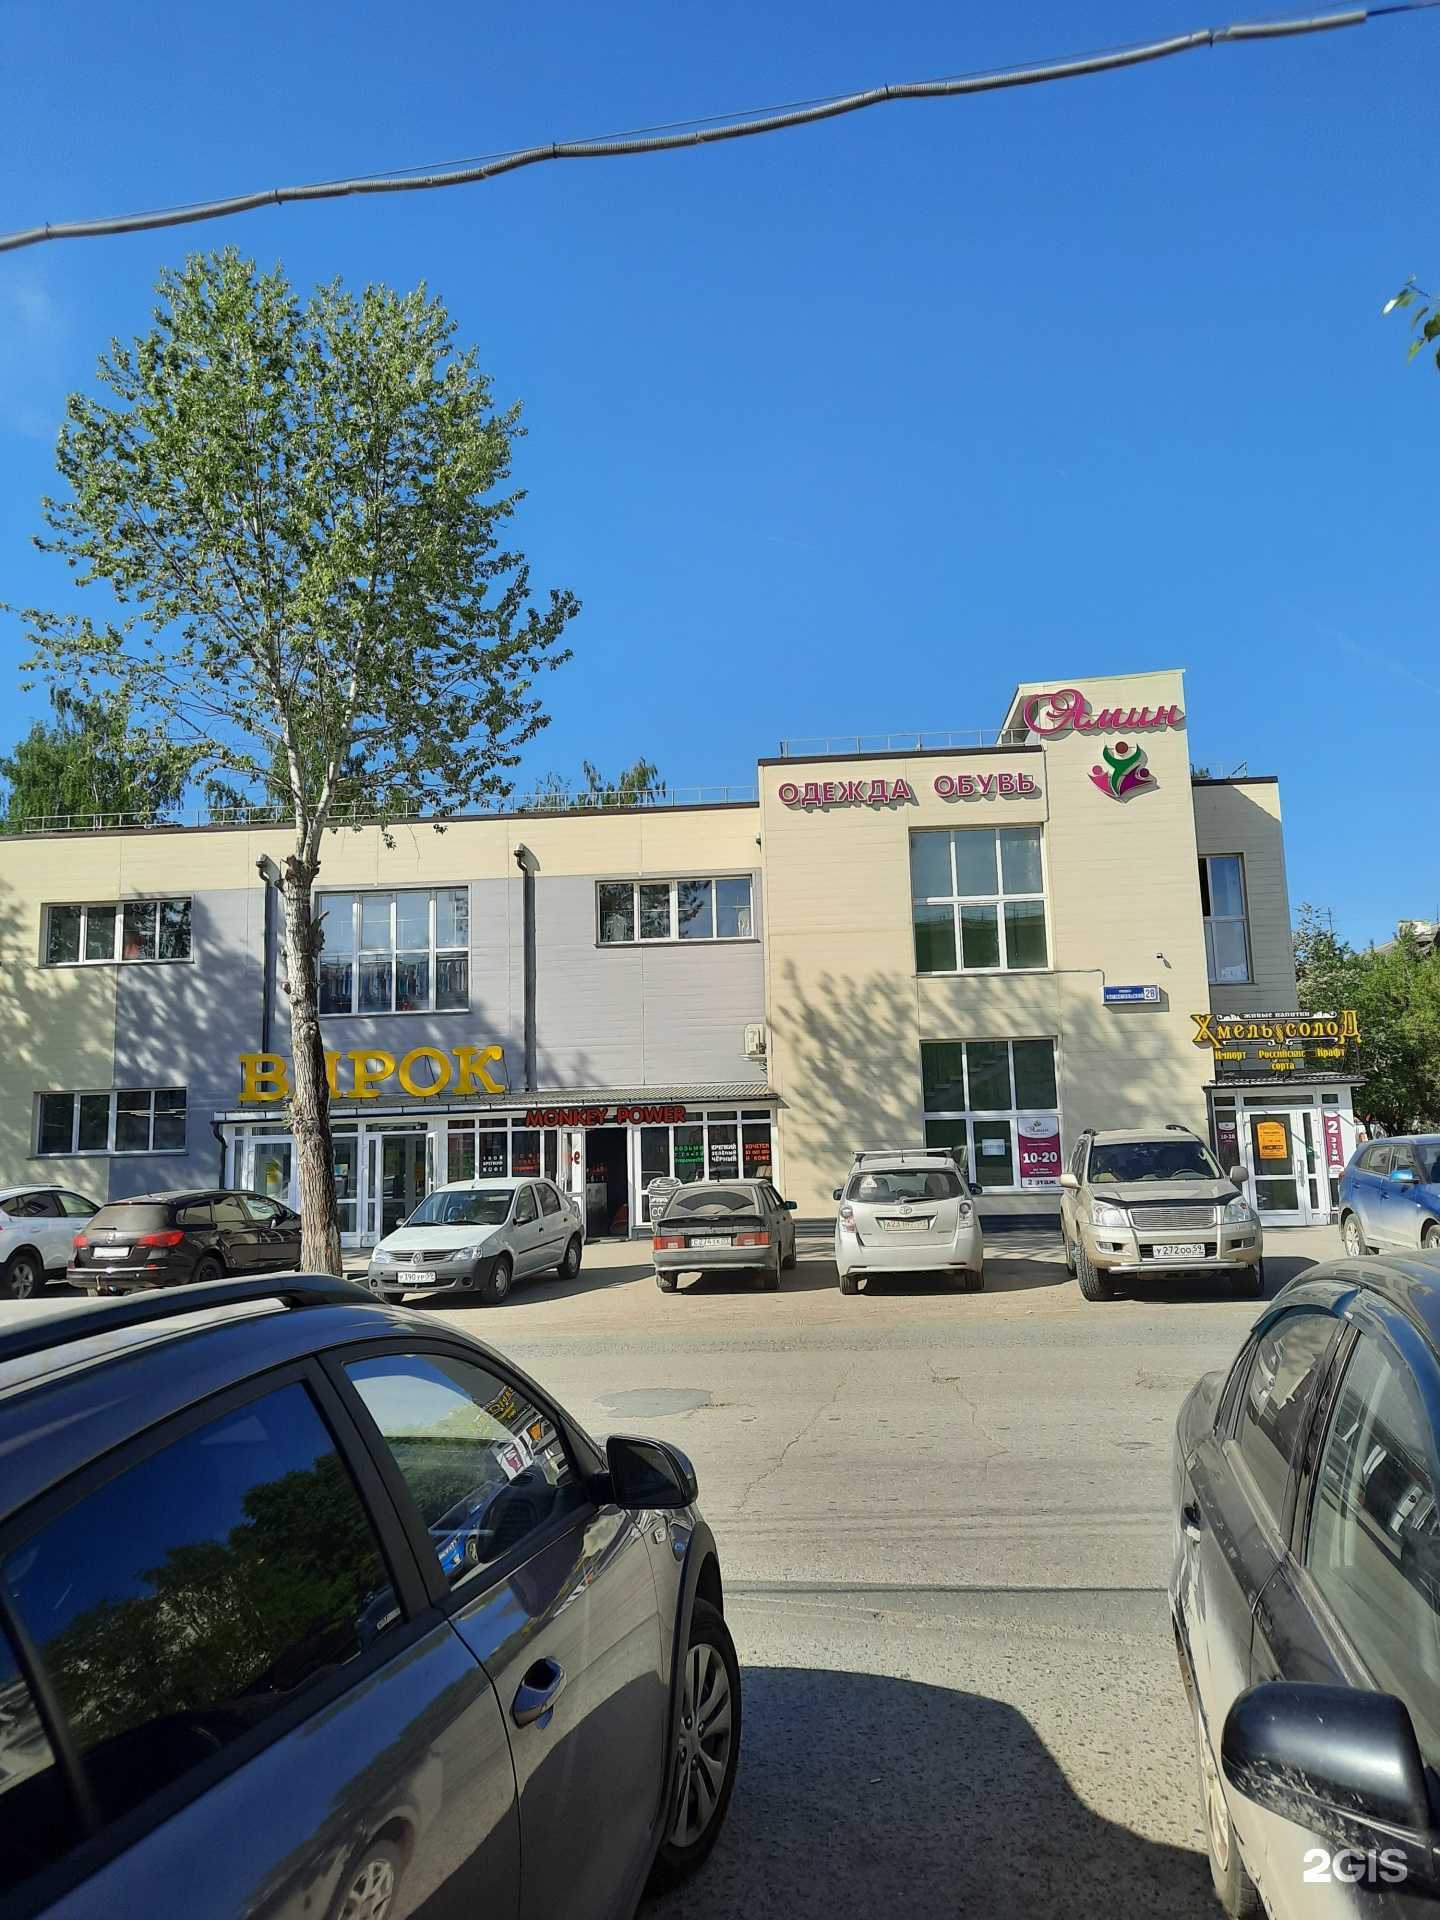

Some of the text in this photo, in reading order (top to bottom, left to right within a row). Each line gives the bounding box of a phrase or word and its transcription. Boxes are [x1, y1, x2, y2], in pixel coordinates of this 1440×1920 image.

[778, 772, 1036, 807] ОДЕЖДА ОБУВЬ
[524, 1105, 687, 1127] MONKEY POWER
[1328, 1120, 1339, 1134] 2
[1023, 1152, 1058, 1164] 10-20
